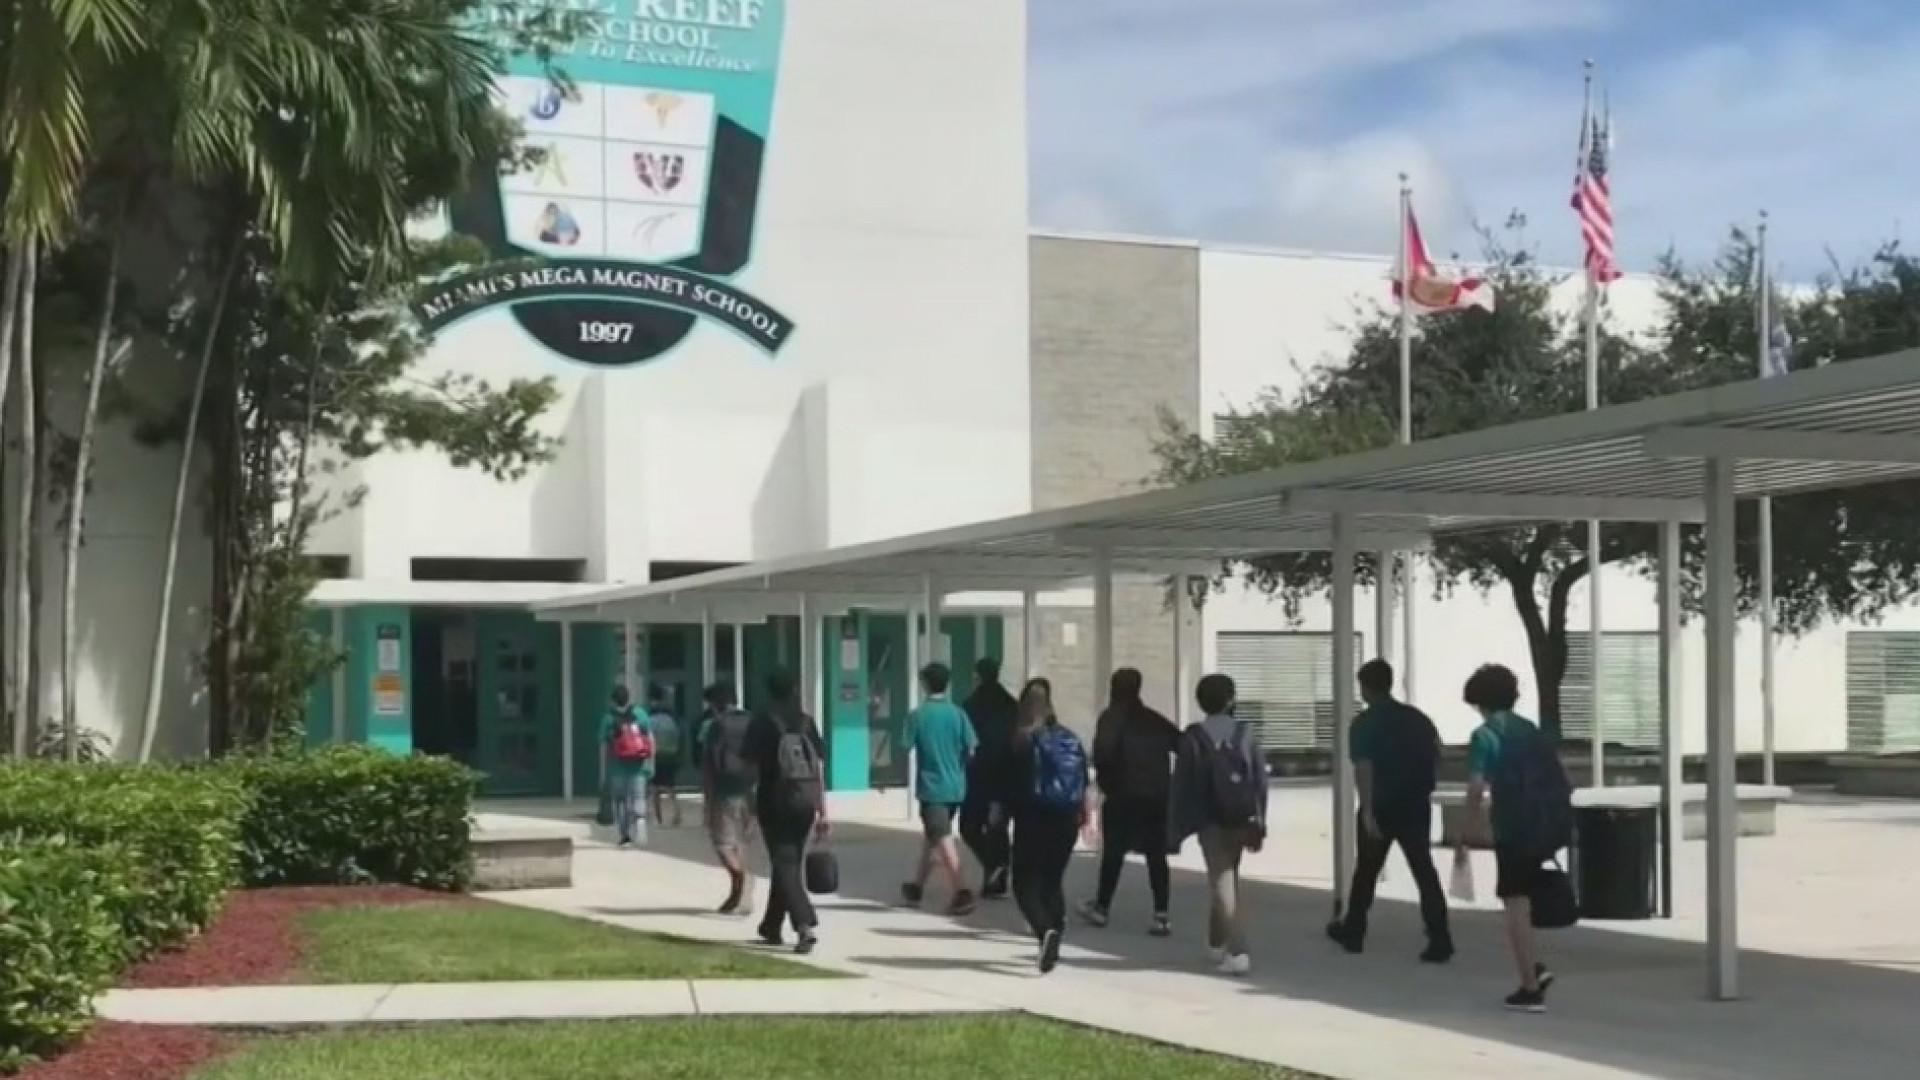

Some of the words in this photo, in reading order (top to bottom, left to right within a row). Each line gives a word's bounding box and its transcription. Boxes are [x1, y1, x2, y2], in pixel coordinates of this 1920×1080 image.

[583, 16, 719, 50] SCHOOL
[519, 265, 588, 288] MEGA
[592, 267, 689, 296] MAGNET
[691, 284, 781, 341] SCHOOL
[579, 321, 634, 344] 1997
